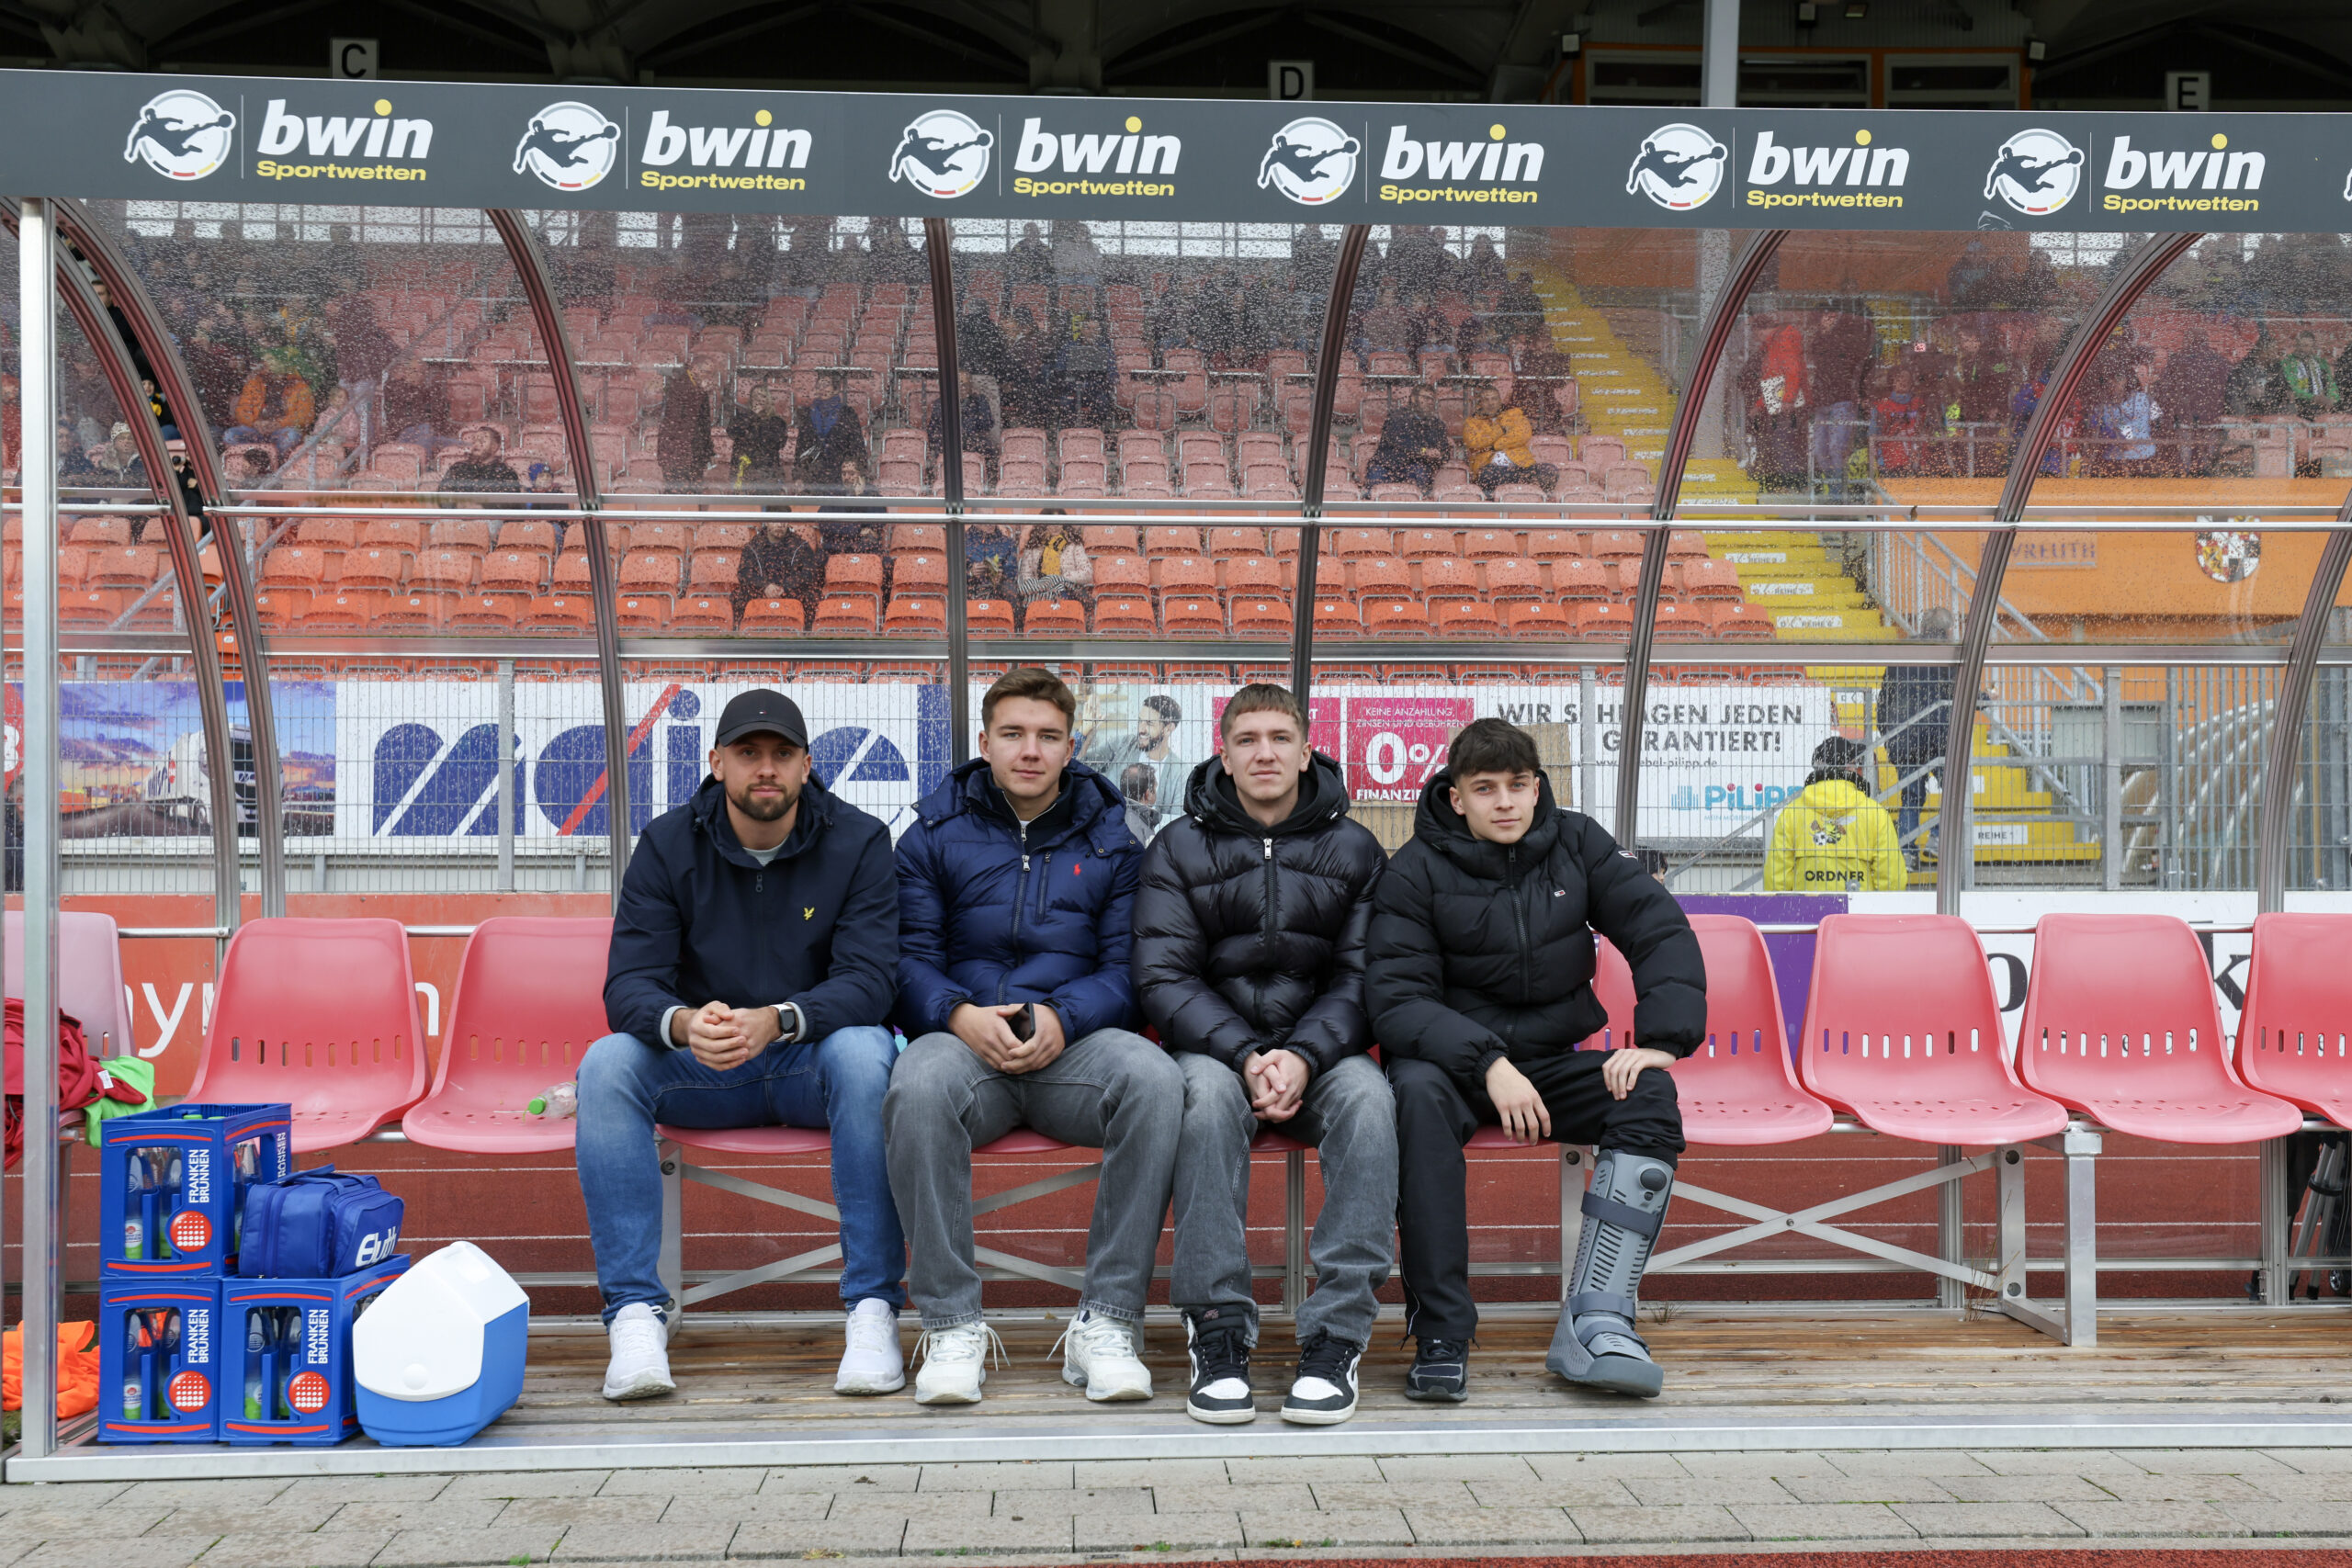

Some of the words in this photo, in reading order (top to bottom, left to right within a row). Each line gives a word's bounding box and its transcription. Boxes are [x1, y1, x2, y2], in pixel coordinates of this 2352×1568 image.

[341, 43, 367, 79] C
[1280, 66, 1303, 100] D
[2178, 77, 2199, 110] E
[258, 99, 433, 159] bwin
[641, 110, 812, 169] bwin
[1014, 117, 1182, 175] bwin
[1380, 124, 1544, 182] bwin
[1747, 130, 1910, 186] bwin
[2104, 134, 2266, 190] bwin
[256, 160, 426, 181] Sportwetten
[641, 171, 806, 191] Sportwetten
[1013, 177, 1175, 197] Sportwetten
[1380, 186, 1538, 204] Sportwetten
[1747, 189, 1904, 209] Sportwetten
[2103, 195, 2259, 213] Sportwetten
[1981, 542, 2096, 558] YREUTH
[1365, 707, 1391, 716] KEINE
[1498, 704, 1551, 724] WIR
[1564, 704, 1708, 726] SHGEN
[1720, 705, 1803, 725] JEDEN
[1603, 729, 1781, 752] GRANTIERT!
[373, 684, 952, 836] maiel
[1356, 789, 1420, 801] FINANZIE
[1977, 831, 2007, 840] REIHE
[1804, 870, 1865, 883] ORDNER
[188, 1149, 199, 1203] FRANKEN
[199, 1149, 209, 1203] BRUNNEN
[187, 1309, 198, 1364] FRANKEN
[198, 1309, 209, 1364] BRUNNEN
[308, 1309, 318, 1364] FRANKEN
[318, 1309, 329, 1364] BRUNNEN
